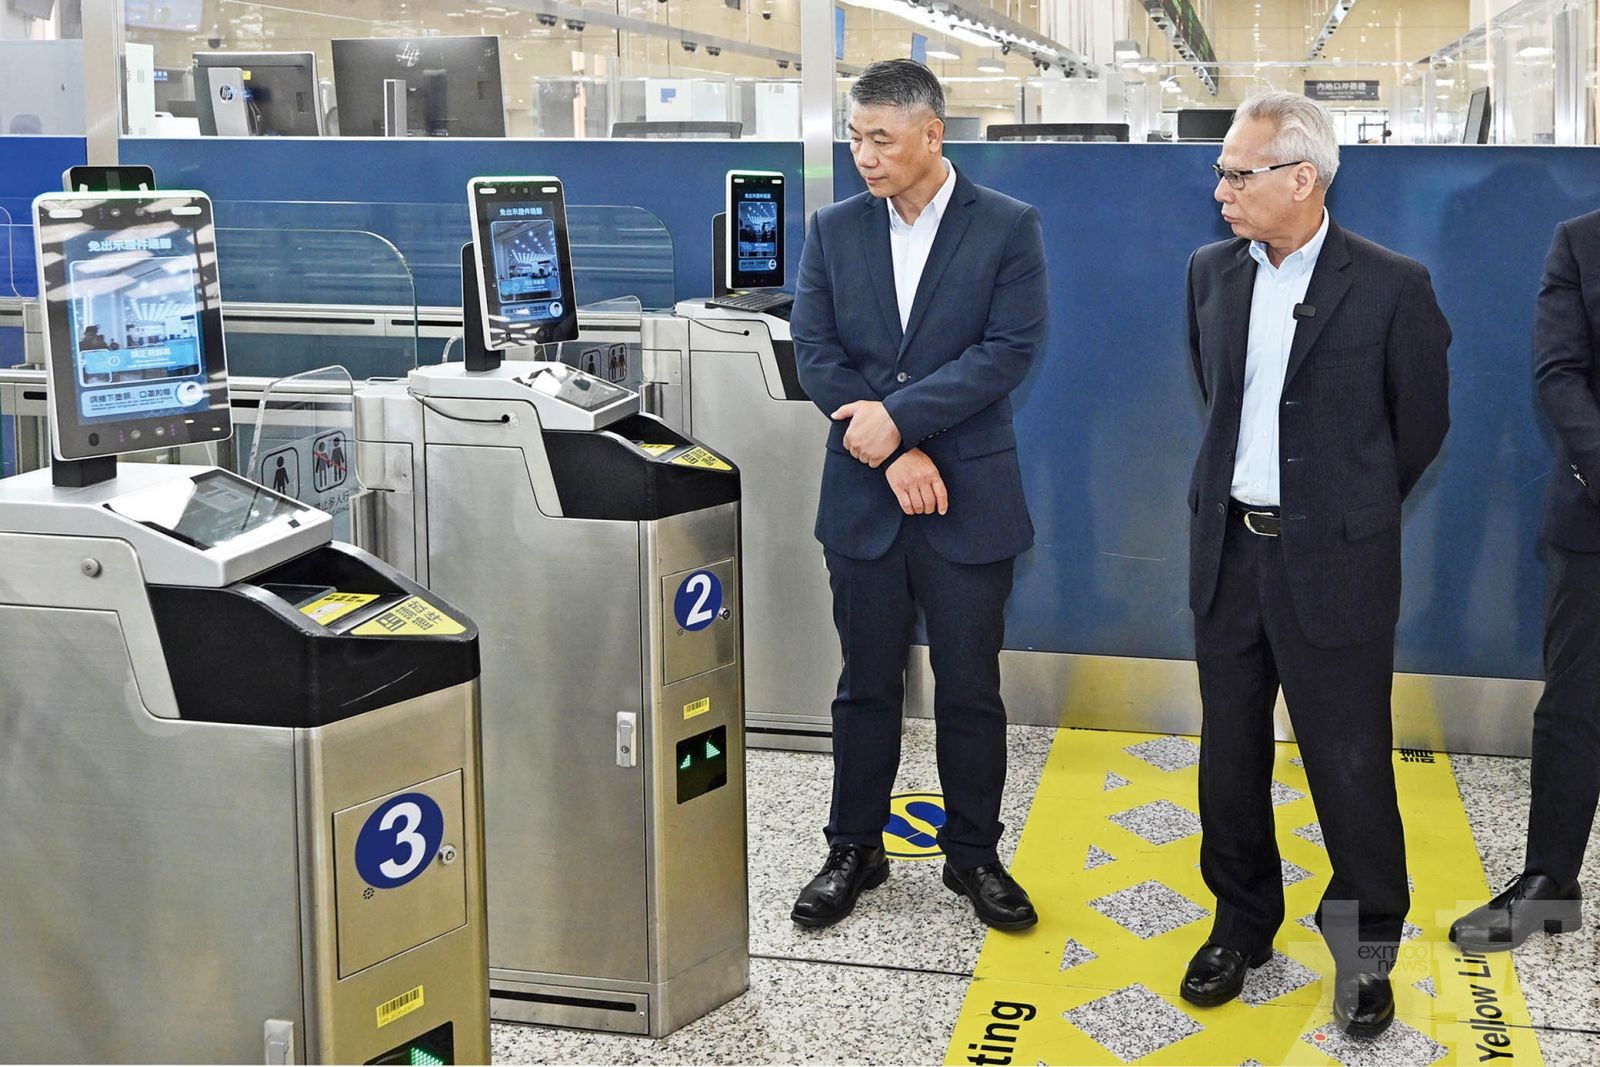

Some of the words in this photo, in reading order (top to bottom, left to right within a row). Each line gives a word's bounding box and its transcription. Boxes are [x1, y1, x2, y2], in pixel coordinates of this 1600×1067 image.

[685, 573, 713, 627] 2
[378, 801, 427, 879] 3
[1469, 984, 1515, 1062] Yellow
